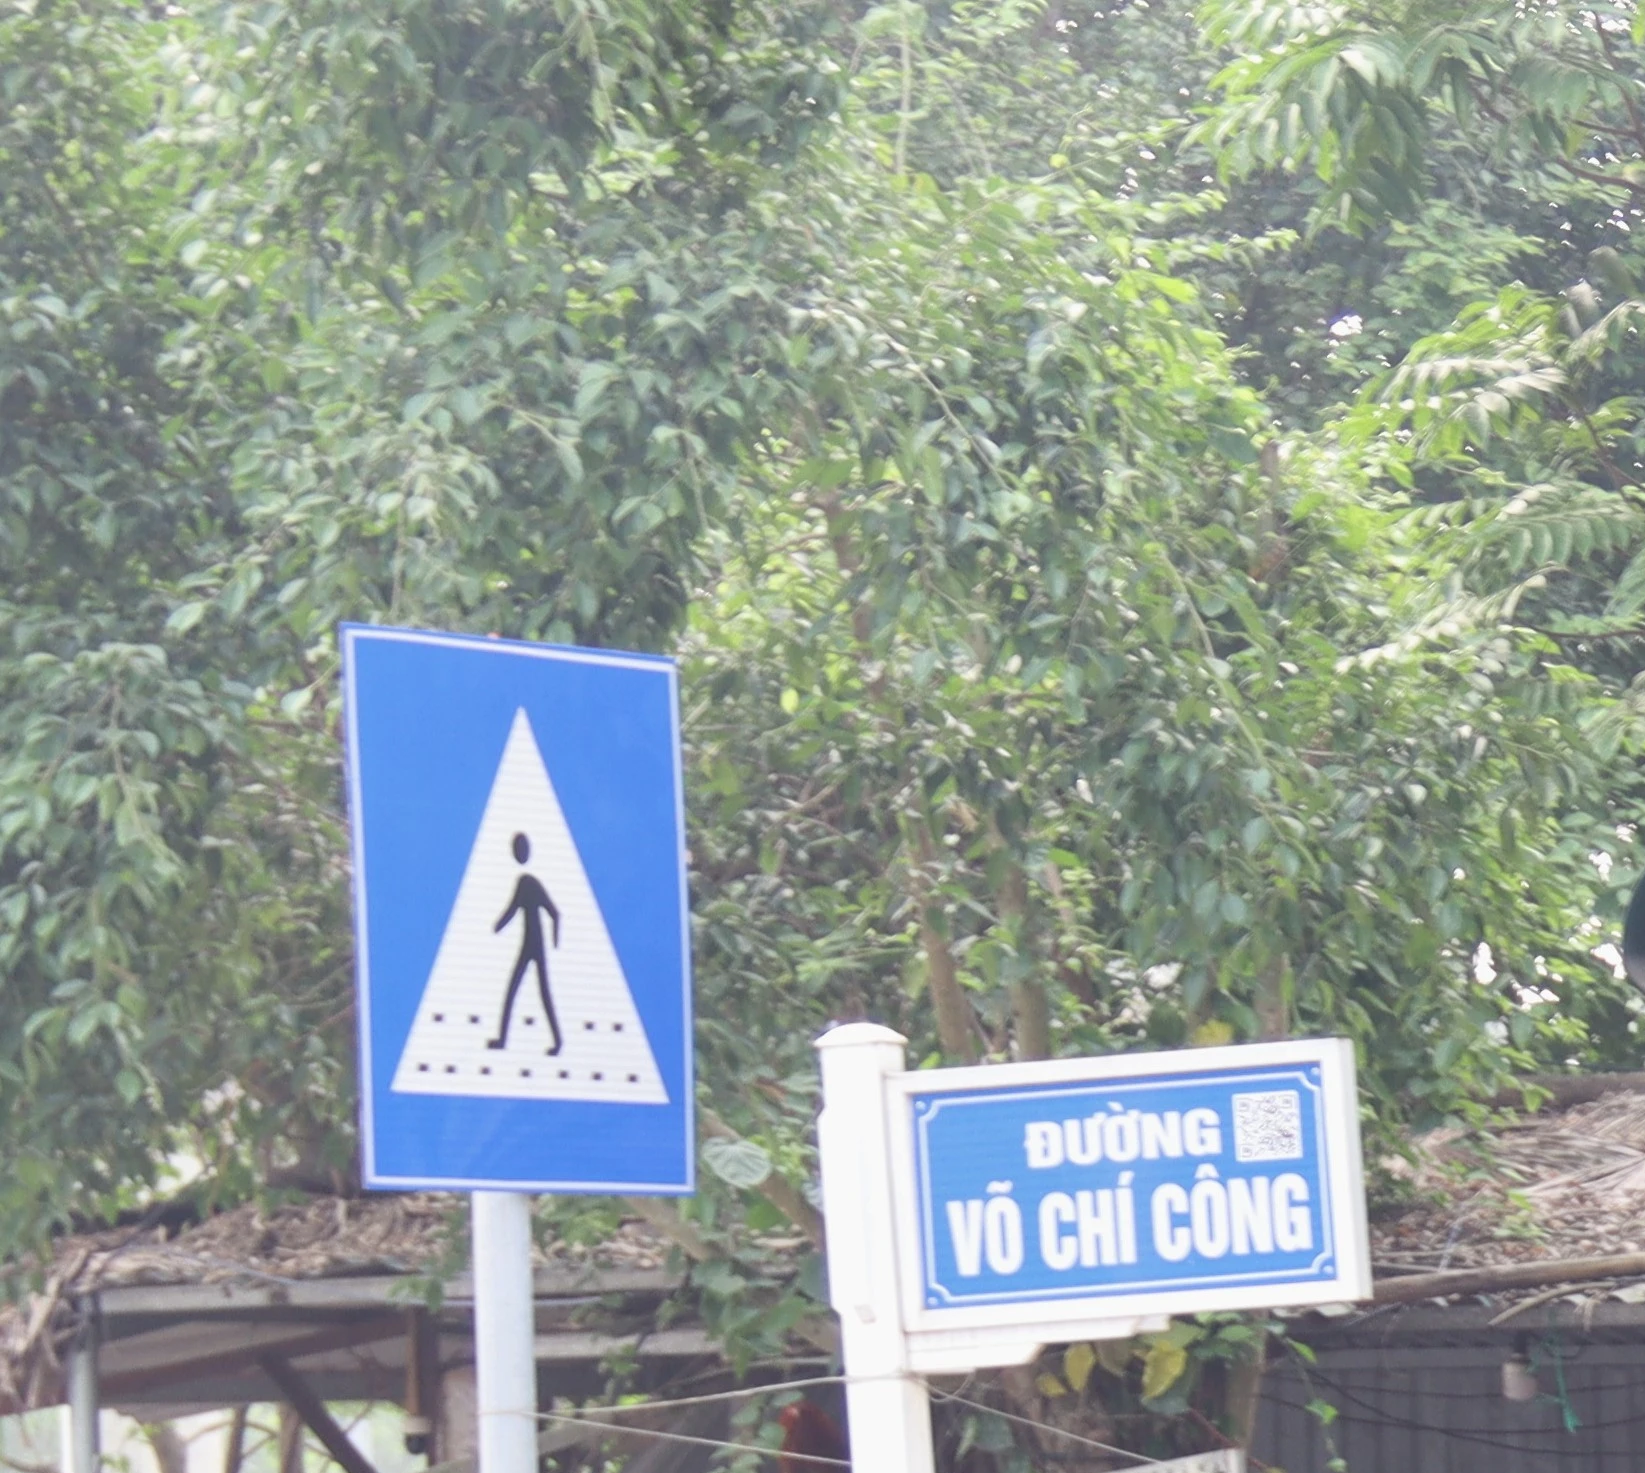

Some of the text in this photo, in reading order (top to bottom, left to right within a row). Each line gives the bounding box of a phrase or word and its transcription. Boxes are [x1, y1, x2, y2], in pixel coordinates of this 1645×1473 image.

[1024, 1101, 1222, 1169] ĐƯỜNG
[946, 1163, 1313, 1277] VÕ CHÍ CÔNG
